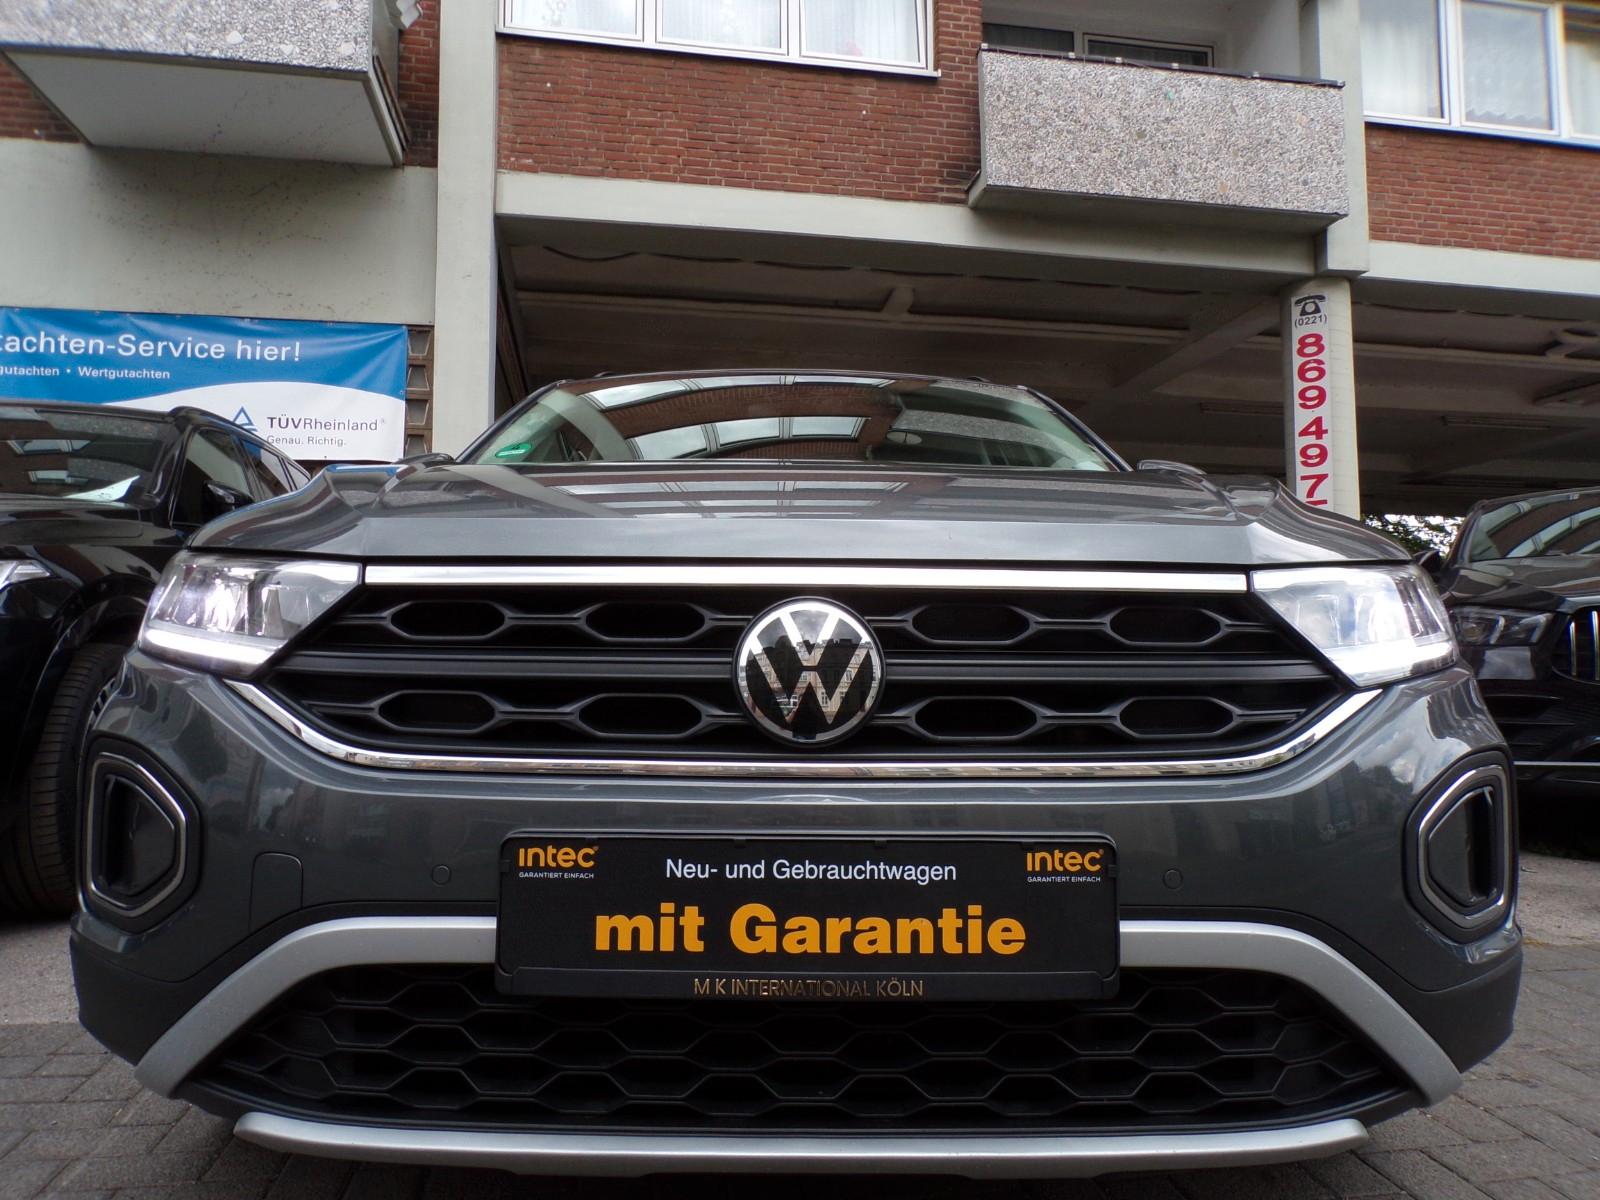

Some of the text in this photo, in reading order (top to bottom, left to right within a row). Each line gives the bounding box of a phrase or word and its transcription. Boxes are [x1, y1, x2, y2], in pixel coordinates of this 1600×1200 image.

[1294, 314, 1328, 329] (0221)
[235, 339, 300, 362] hier!
[78, 366, 171, 380] Wertgutachten
[266, 435, 347, 447] Genau. Richtig.
[518, 845, 596, 868] intec
[1026, 849, 1102, 872] intec
[519, 871, 562, 879] GARANTIERT
[665, 858, 957, 885] Neu- und Gebrauchtwagen
[1027, 875, 1070, 883] GARANTIERT
[595, 902, 1026, 955] mit Garantie
[731, 979, 870, 997] INTERNATIONAL
[876, 977, 924, 997] KÖLN
